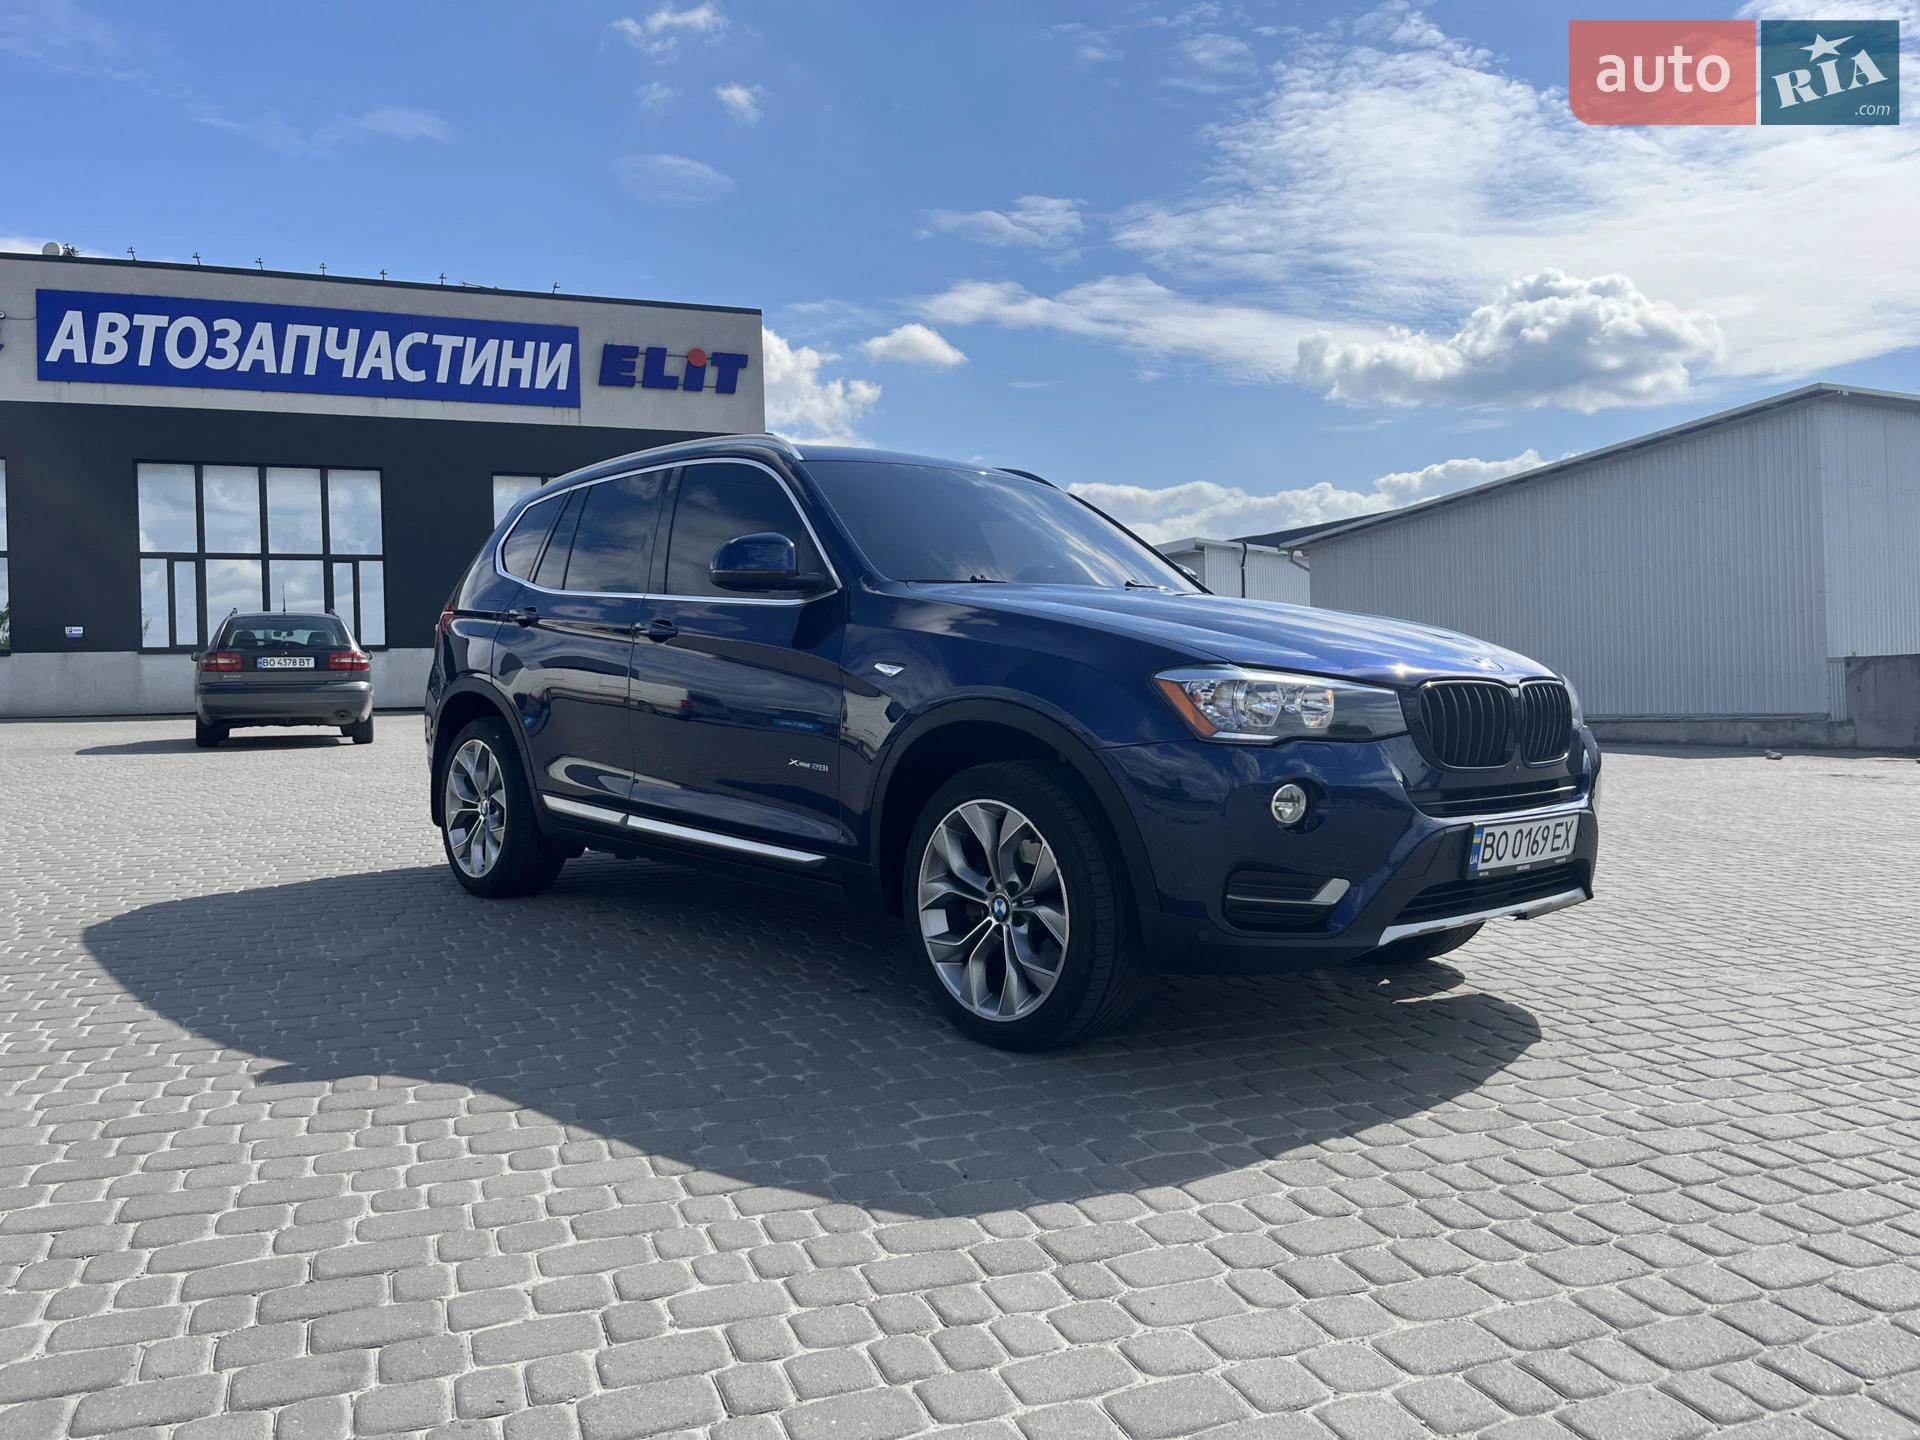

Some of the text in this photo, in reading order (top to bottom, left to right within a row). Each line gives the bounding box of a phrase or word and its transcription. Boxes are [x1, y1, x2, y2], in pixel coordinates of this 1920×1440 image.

[44, 309, 573, 391] АВТОЗАПЧАСТИНИ
[277, 658, 297, 667] 4378
[1480, 819, 1575, 864] BO 0169 EX
